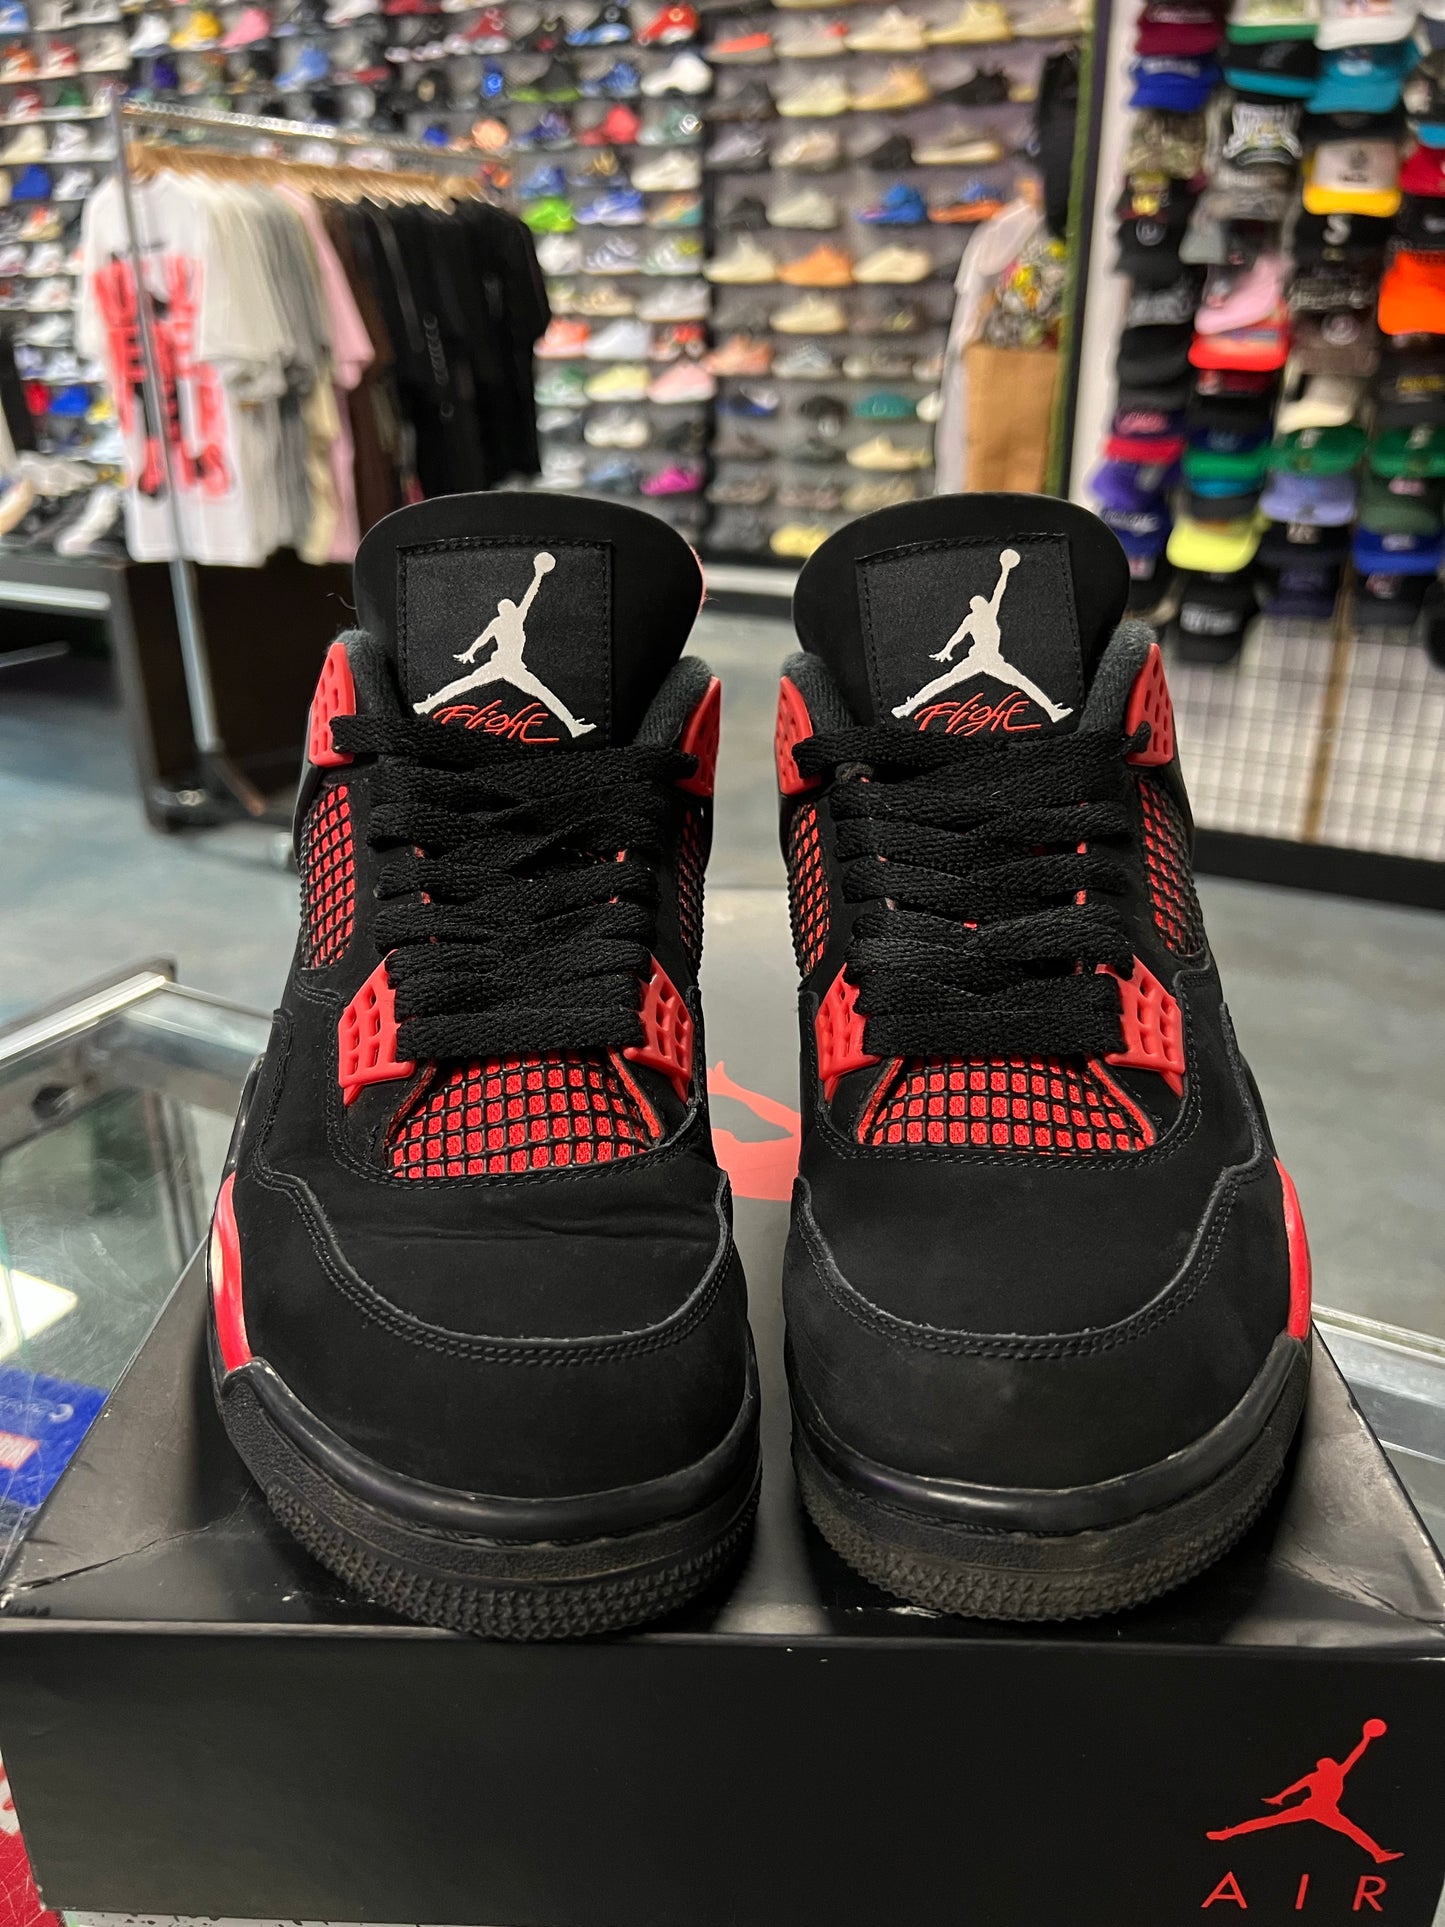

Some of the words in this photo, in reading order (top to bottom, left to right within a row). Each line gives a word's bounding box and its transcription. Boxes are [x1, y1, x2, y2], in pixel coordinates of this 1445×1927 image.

[433, 700, 560, 744] Flight
[914, 692, 1041, 737] Flight
[1201, 1871, 1388, 1912] AIR
